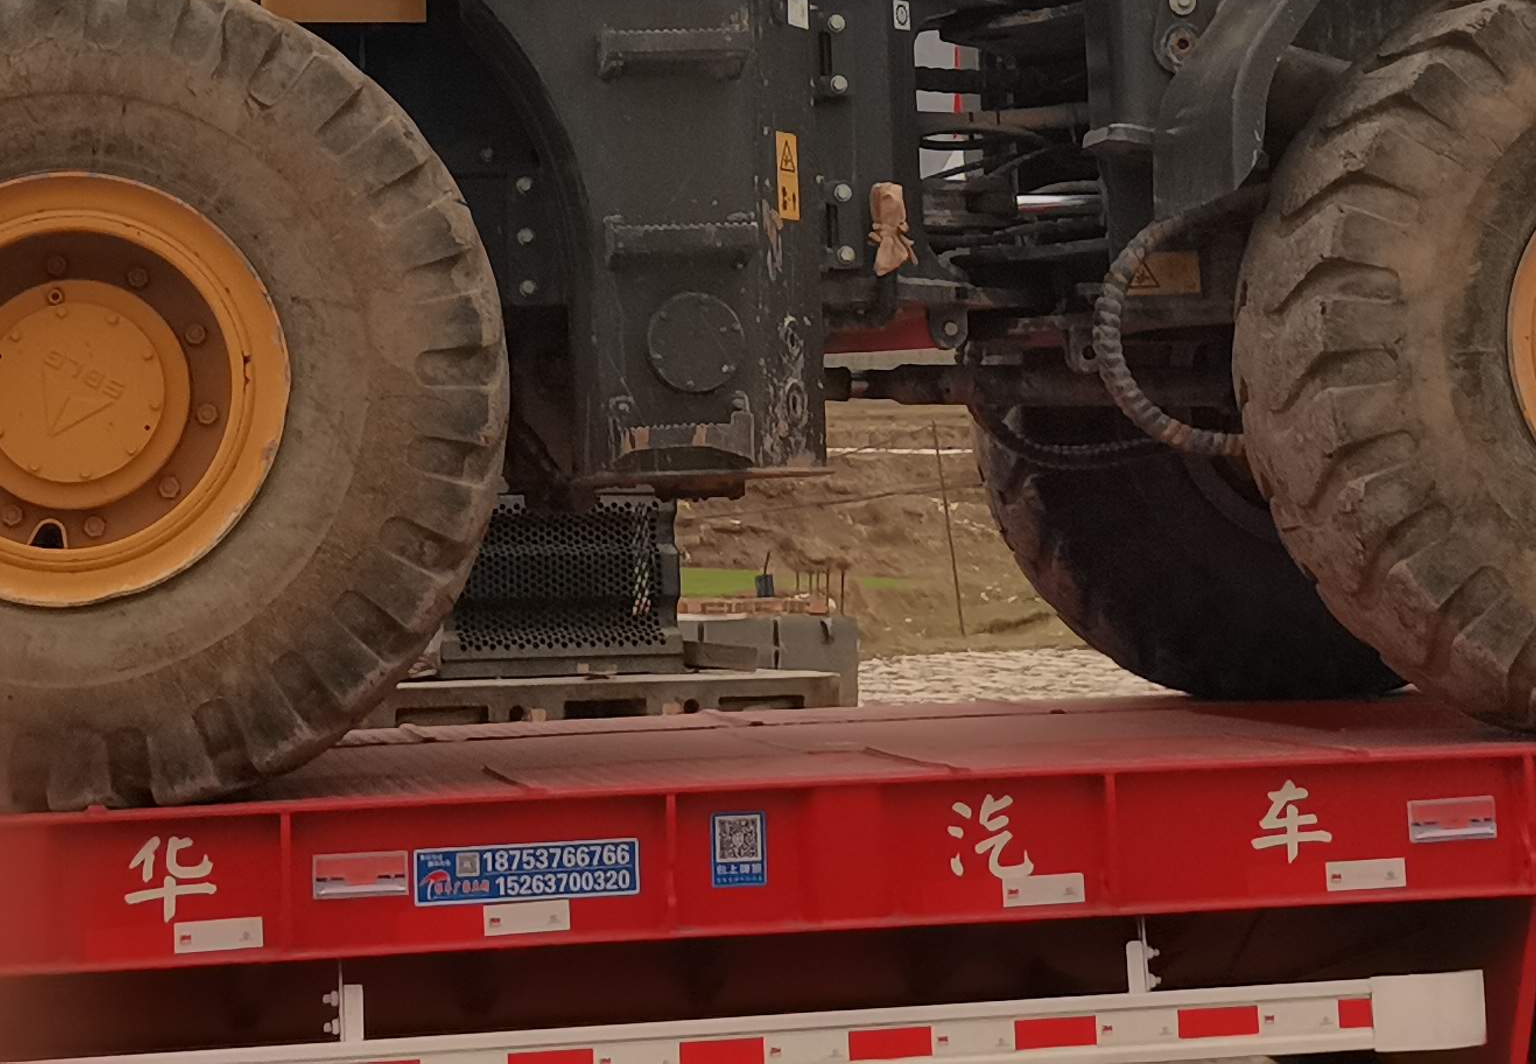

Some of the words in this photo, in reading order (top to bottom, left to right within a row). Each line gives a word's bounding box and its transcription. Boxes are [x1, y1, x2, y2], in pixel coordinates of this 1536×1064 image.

[124, 836, 217, 923] 华
[947, 793, 1034, 879] 汽
[1250, 779, 1333, 864] 车
[483, 844, 630, 872] 18753766766
[495, 869, 630, 896] 15263700320
